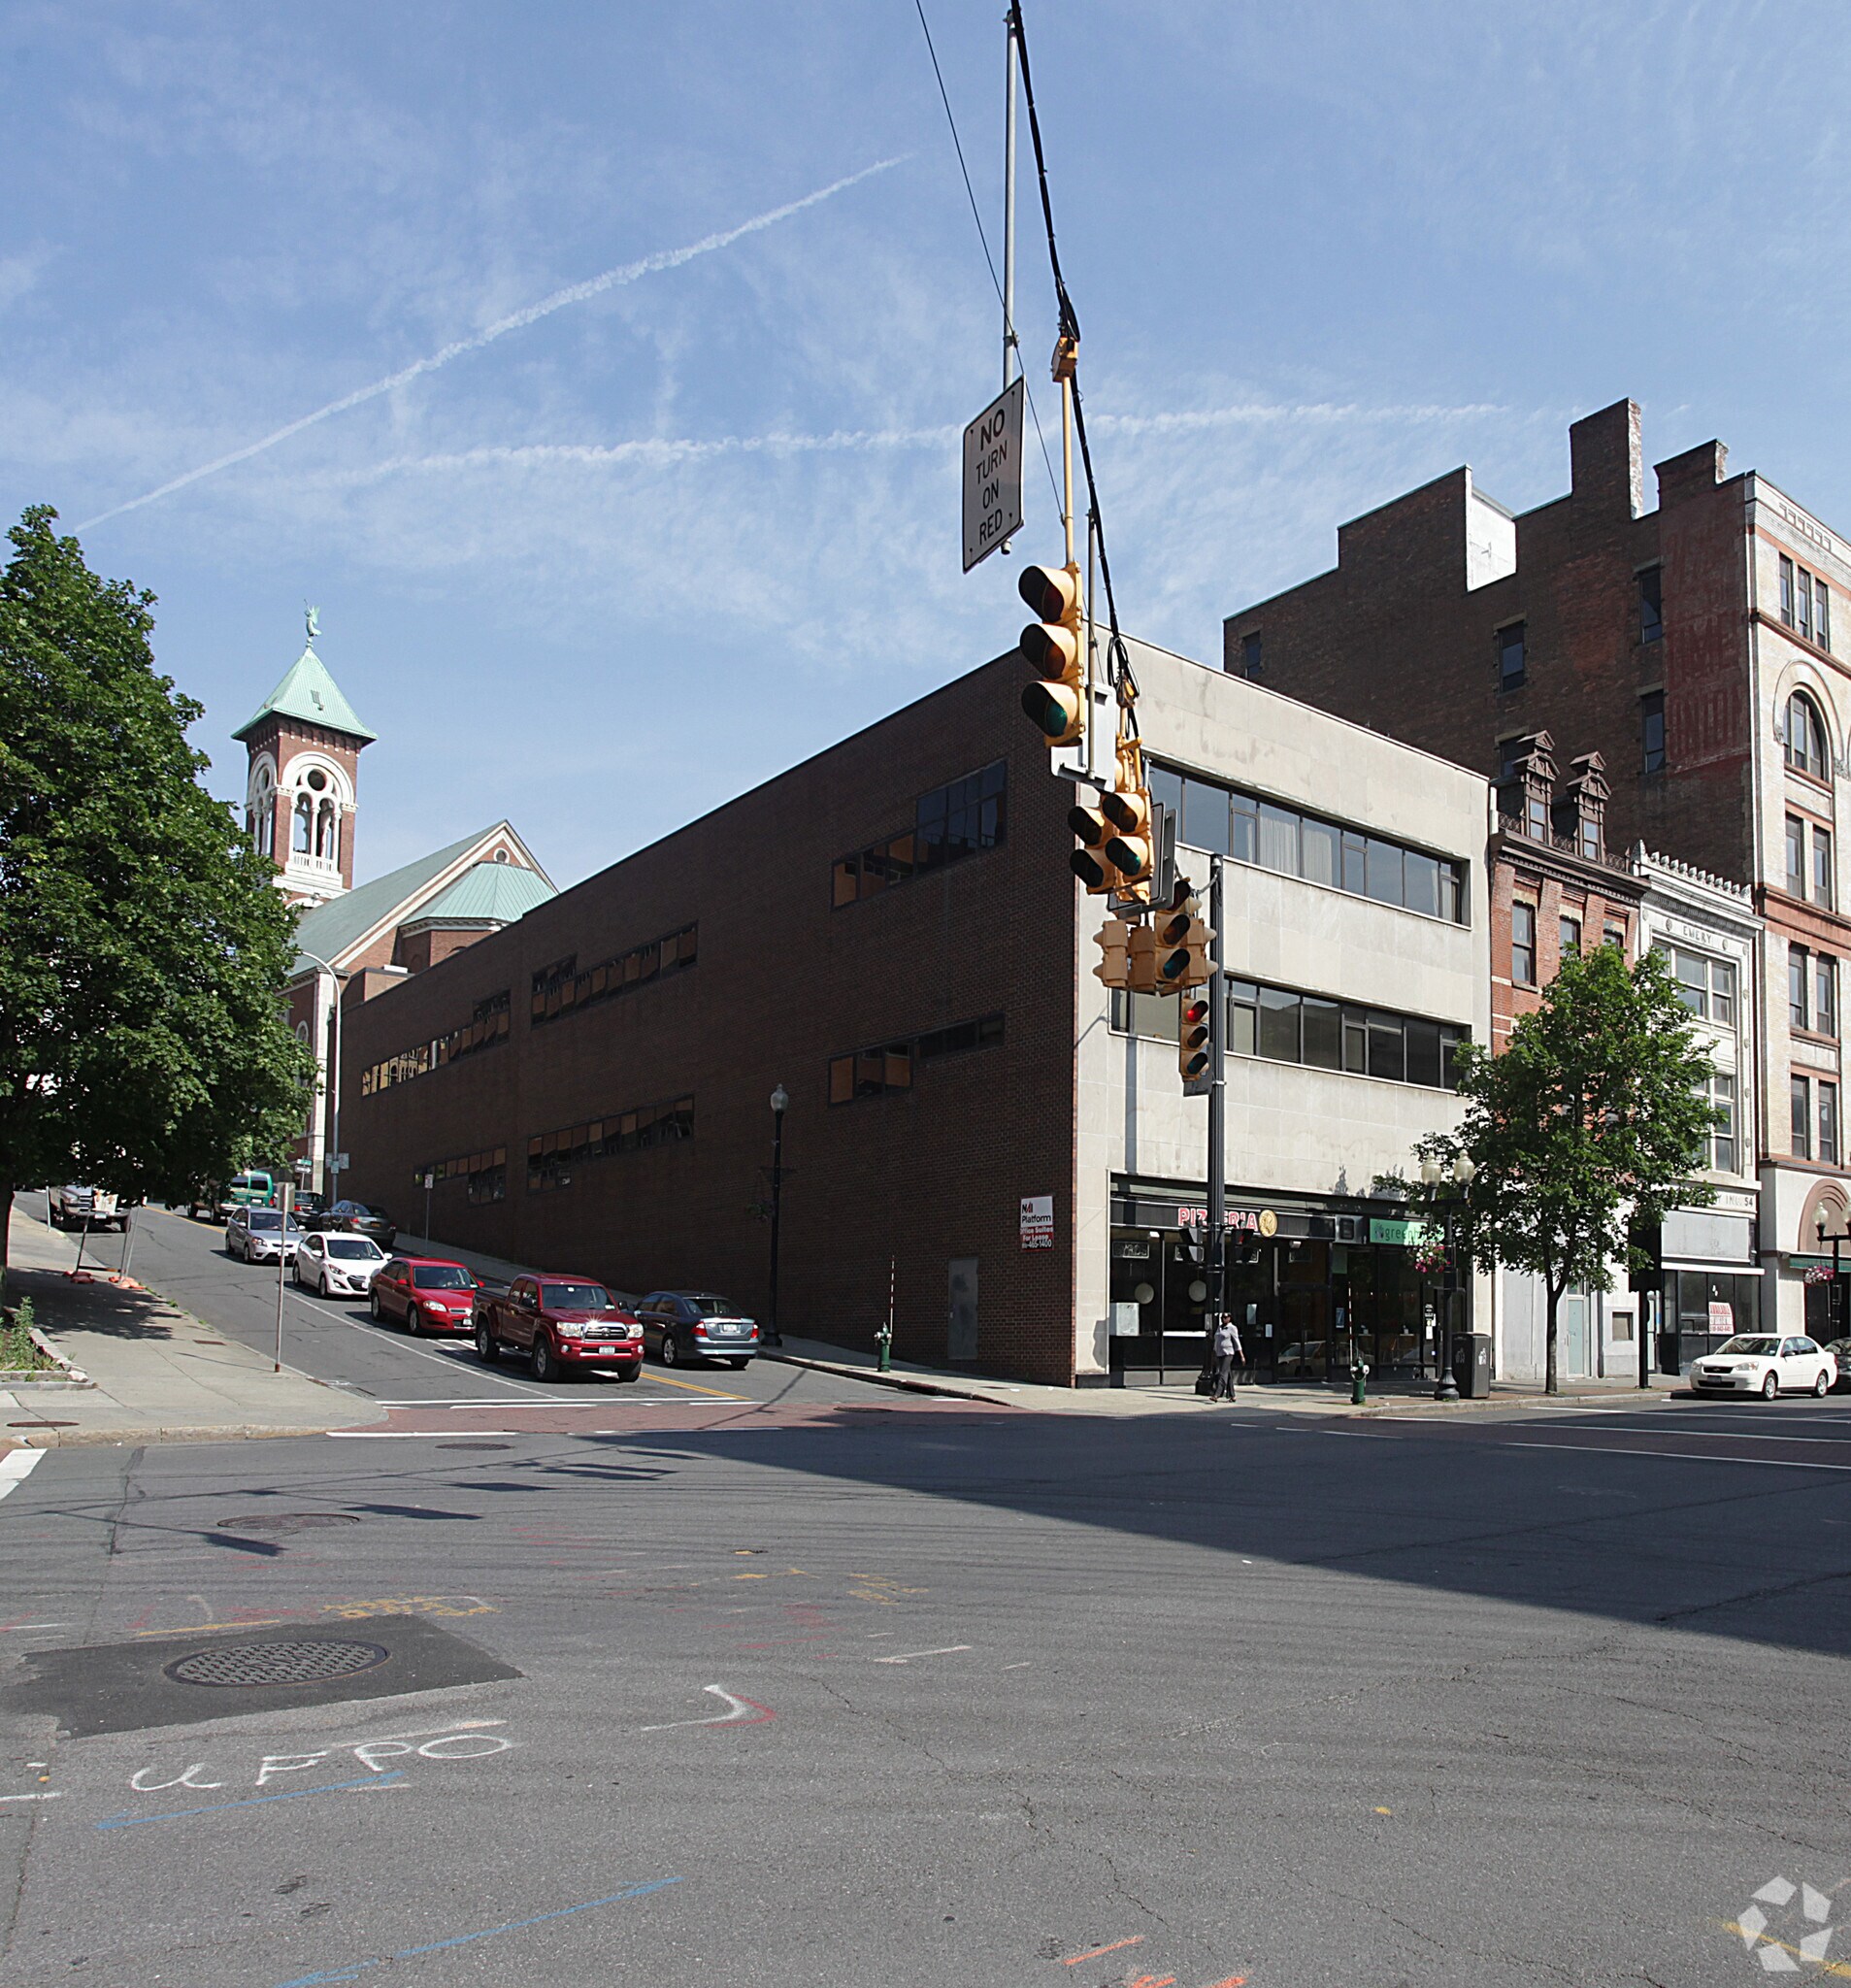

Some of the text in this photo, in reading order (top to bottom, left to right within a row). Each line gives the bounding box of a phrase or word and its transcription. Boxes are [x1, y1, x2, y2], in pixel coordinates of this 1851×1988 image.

[979, 408, 1005, 450] NO
[975, 440, 1008, 484] TURN
[982, 479, 999, 510] ON
[979, 508, 1003, 546] RED
[1682, 925, 1712, 944] EMERY
[1021, 1214, 1051, 1223] Platform
[1022, 1202, 1033, 1213] NAI
[1177, 1207, 1259, 1232] PIZERIA
